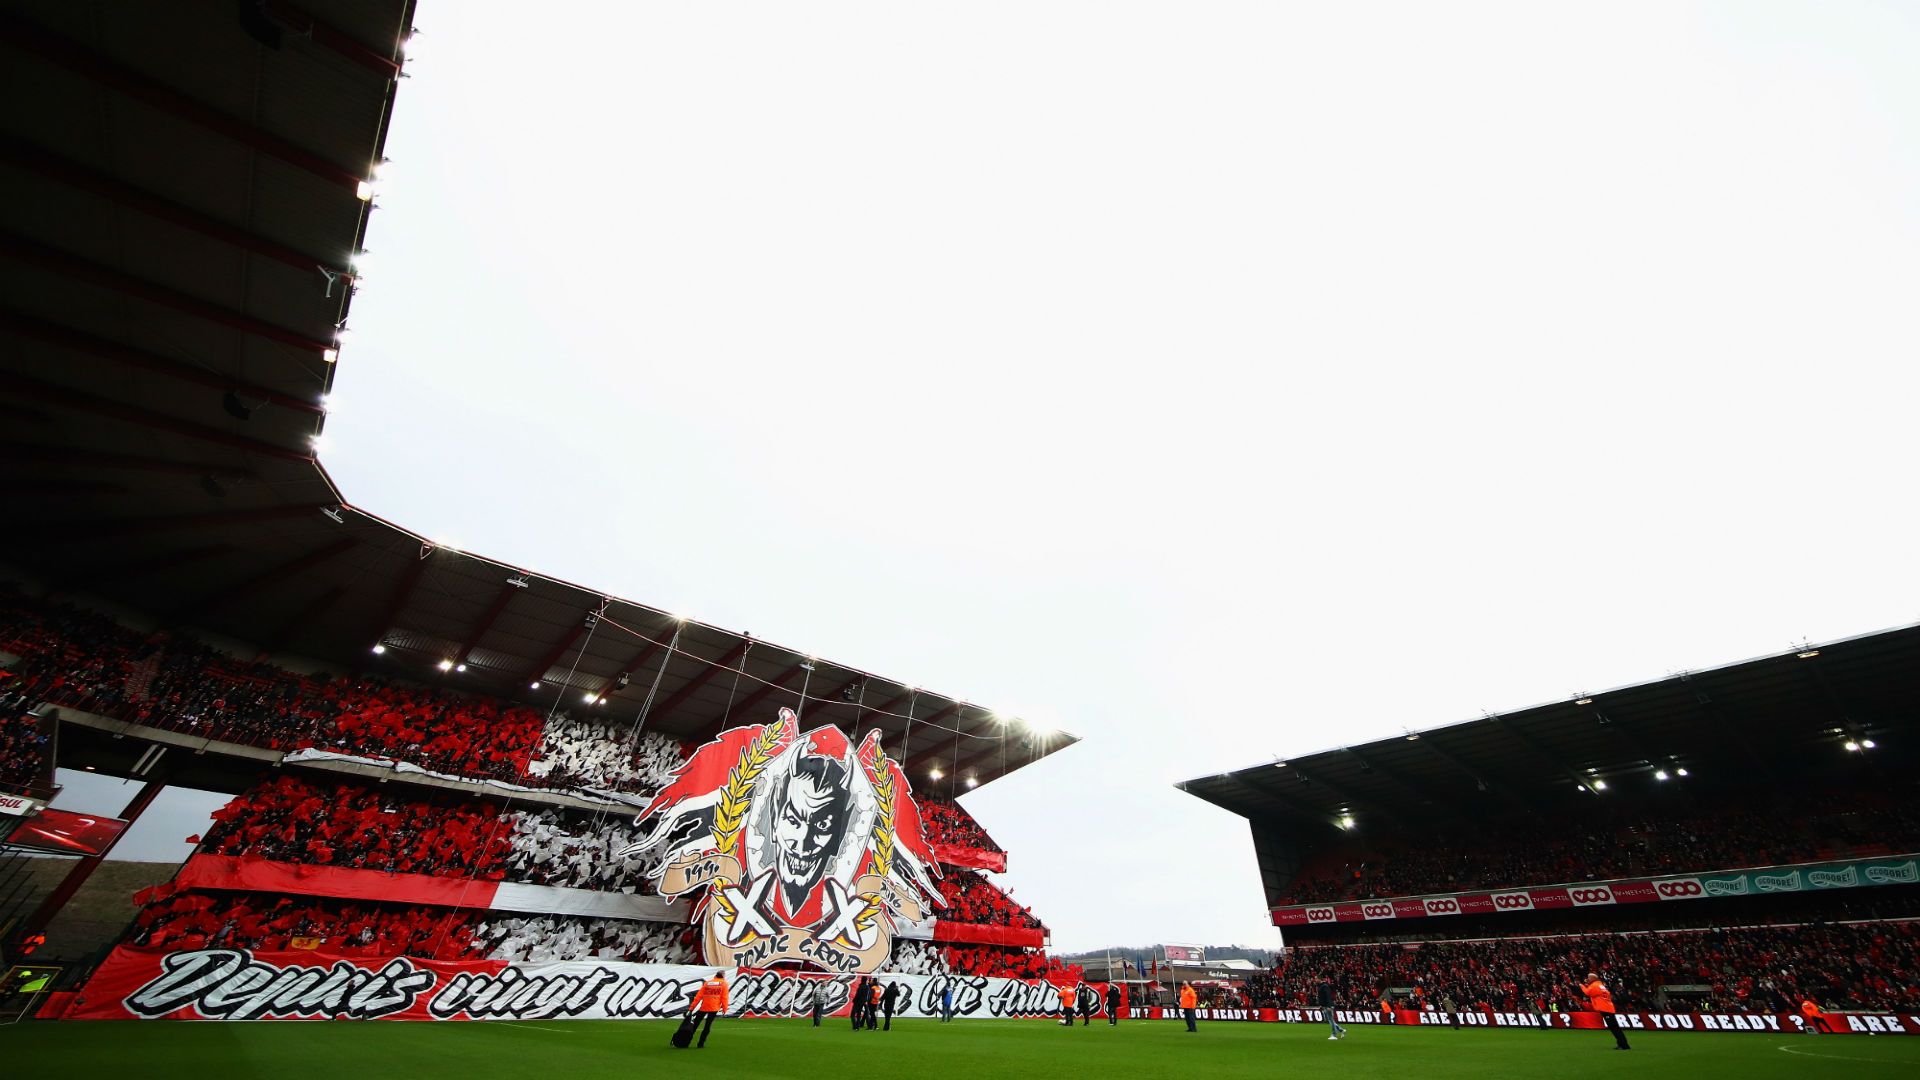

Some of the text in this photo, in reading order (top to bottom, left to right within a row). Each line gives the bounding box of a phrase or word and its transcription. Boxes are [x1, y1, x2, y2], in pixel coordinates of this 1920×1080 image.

[734, 935, 861, 972] TOXIC GROUP
[124, 949, 437, 1019] Depuis
[430, 966, 619, 1018] vingt
[604, 976, 706, 1018] ans
[1213, 1008, 1248, 1020] READY
[1278, 1010, 1302, 1022] ARE
[1305, 1010, 1323, 1021] YO
[1336, 1010, 1381, 1023] READY
[1419, 1012, 1450, 1024] ARE
[1456, 1012, 1488, 1025] YOU
[1603, 1014, 1644, 1028] RE
[1648, 1014, 1694, 1029] YOU
[1700, 1014, 1780, 1031] READY
[1846, 1015, 1906, 1032] ARE
